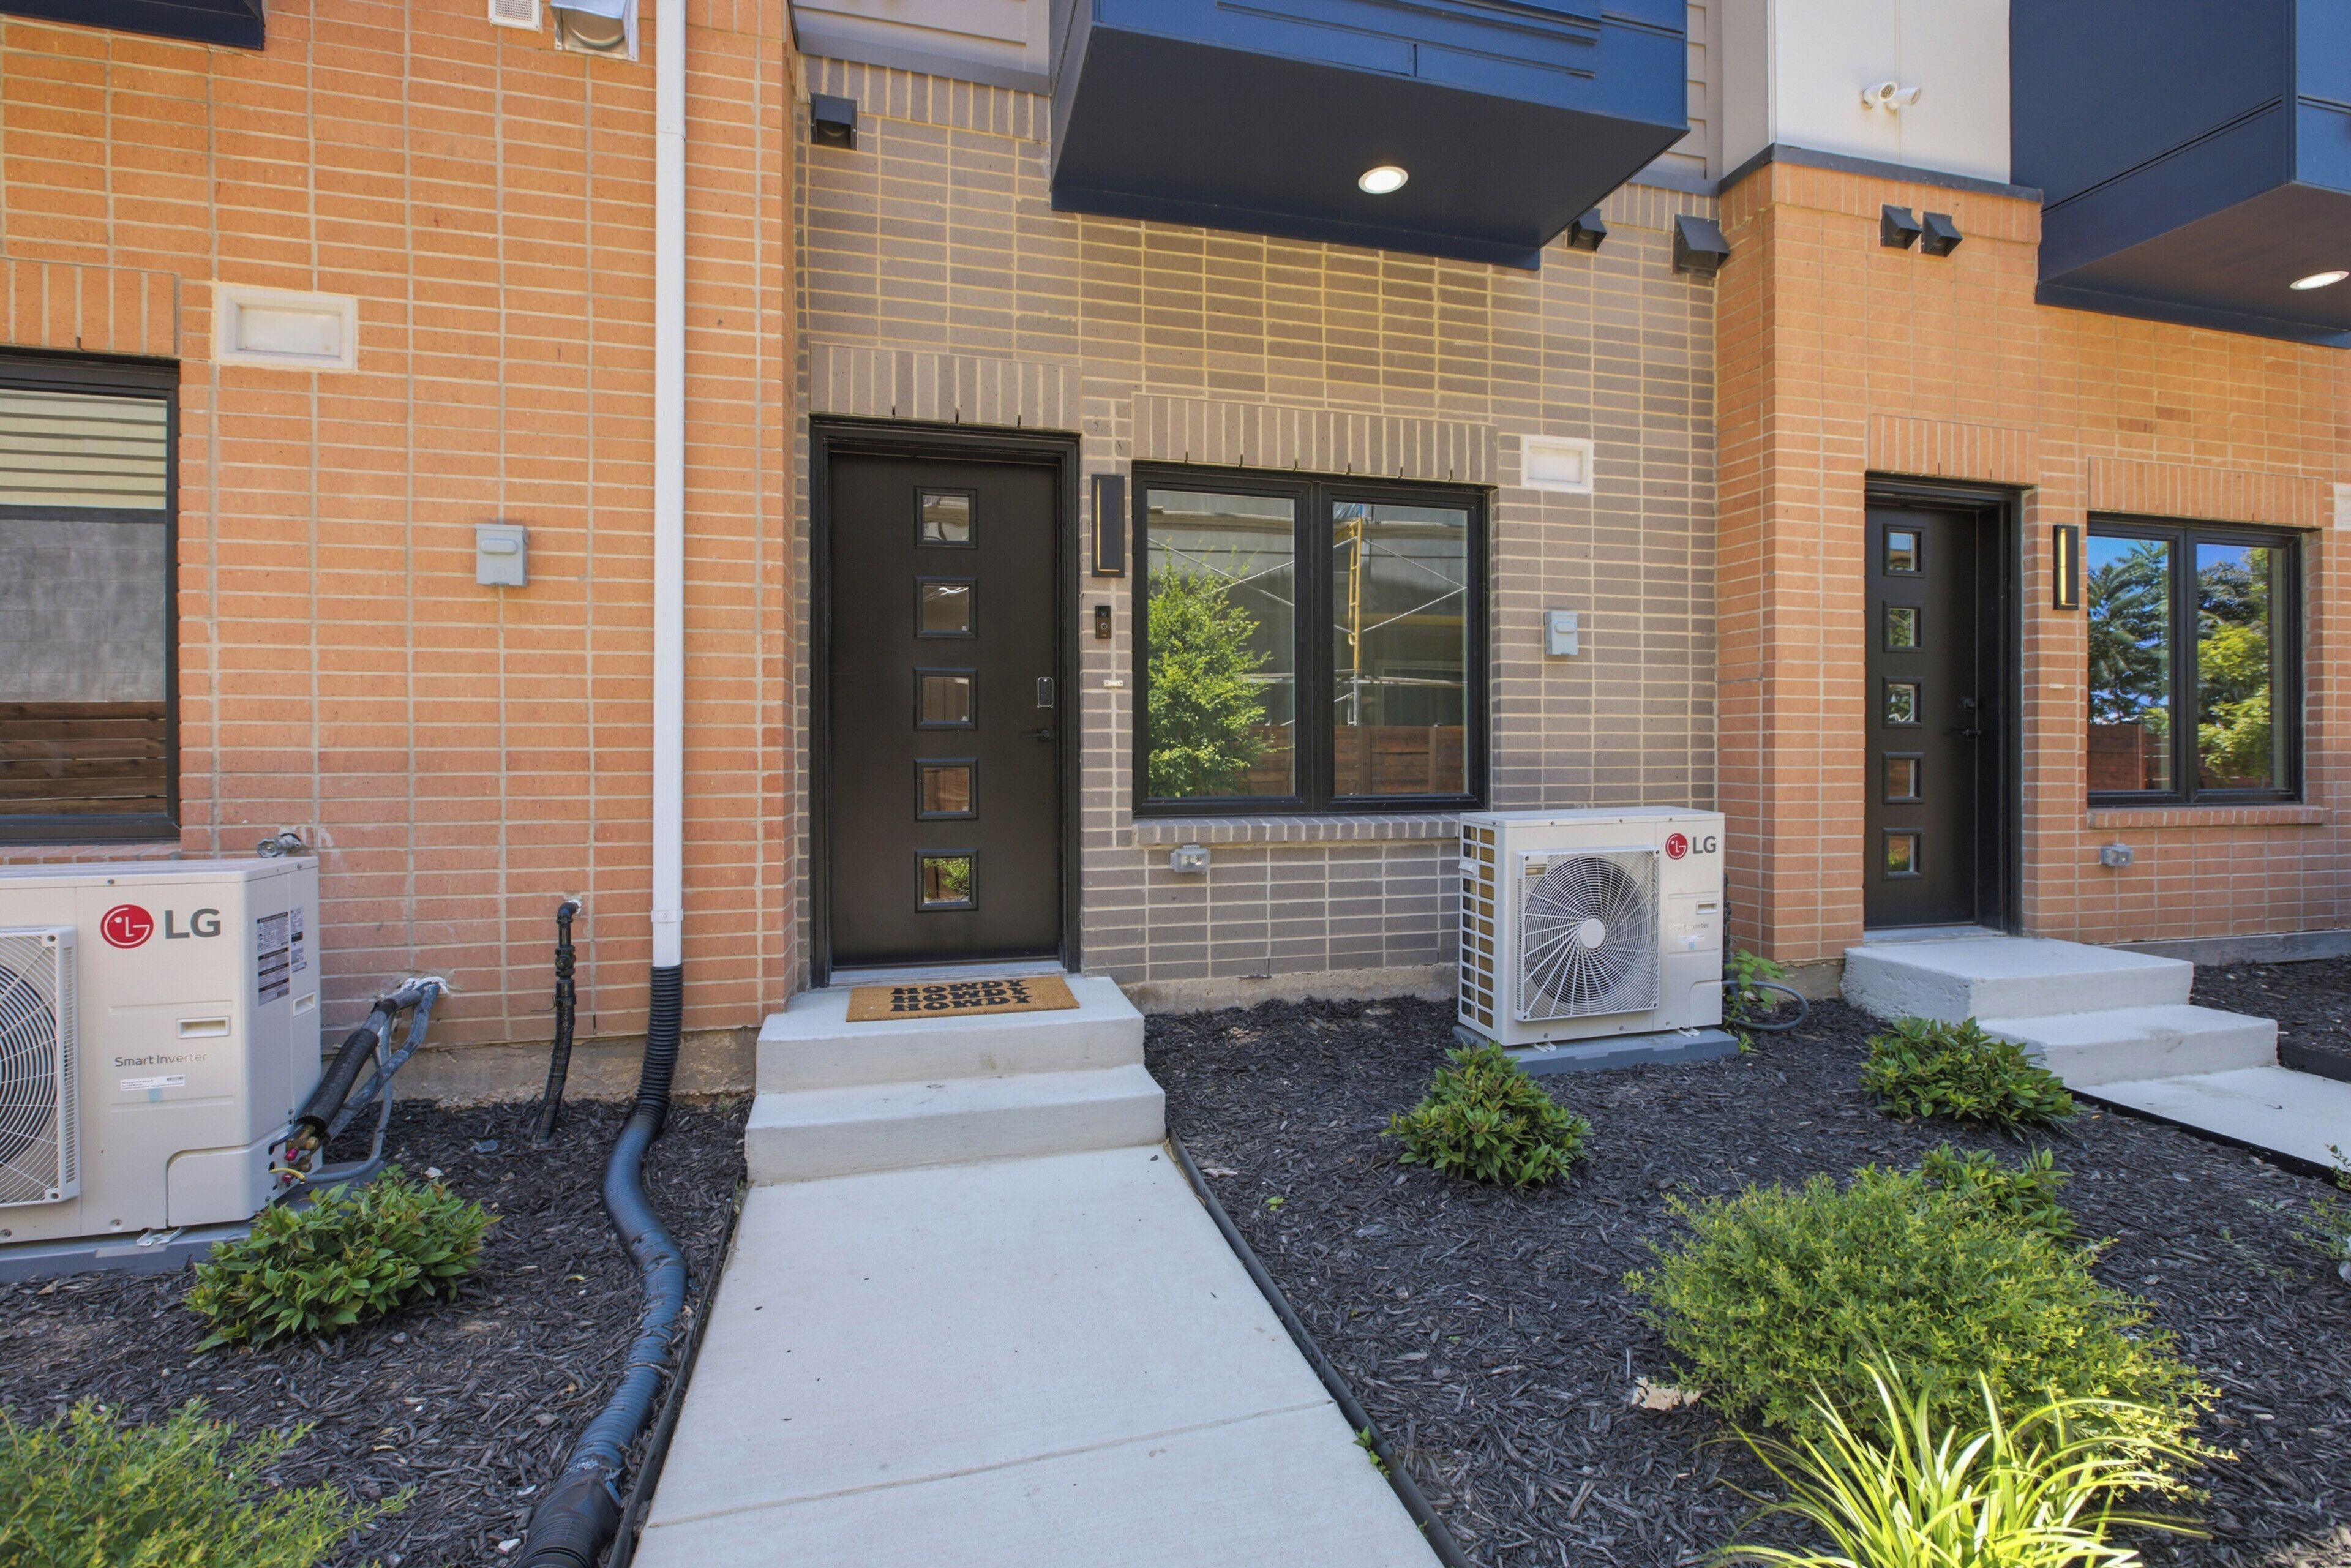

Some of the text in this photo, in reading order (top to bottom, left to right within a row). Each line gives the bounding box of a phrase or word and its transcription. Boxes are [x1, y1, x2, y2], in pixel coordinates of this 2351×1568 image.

[1693, 836, 1716, 854] LG
[165, 908, 221, 939] LG
[891, 980, 1026, 995] HOWDY
[891, 987, 1030, 1003] HOWDY
[891, 995, 1032, 1011] HOWDY
[115, 1053, 207, 1067] Smart Inverter
